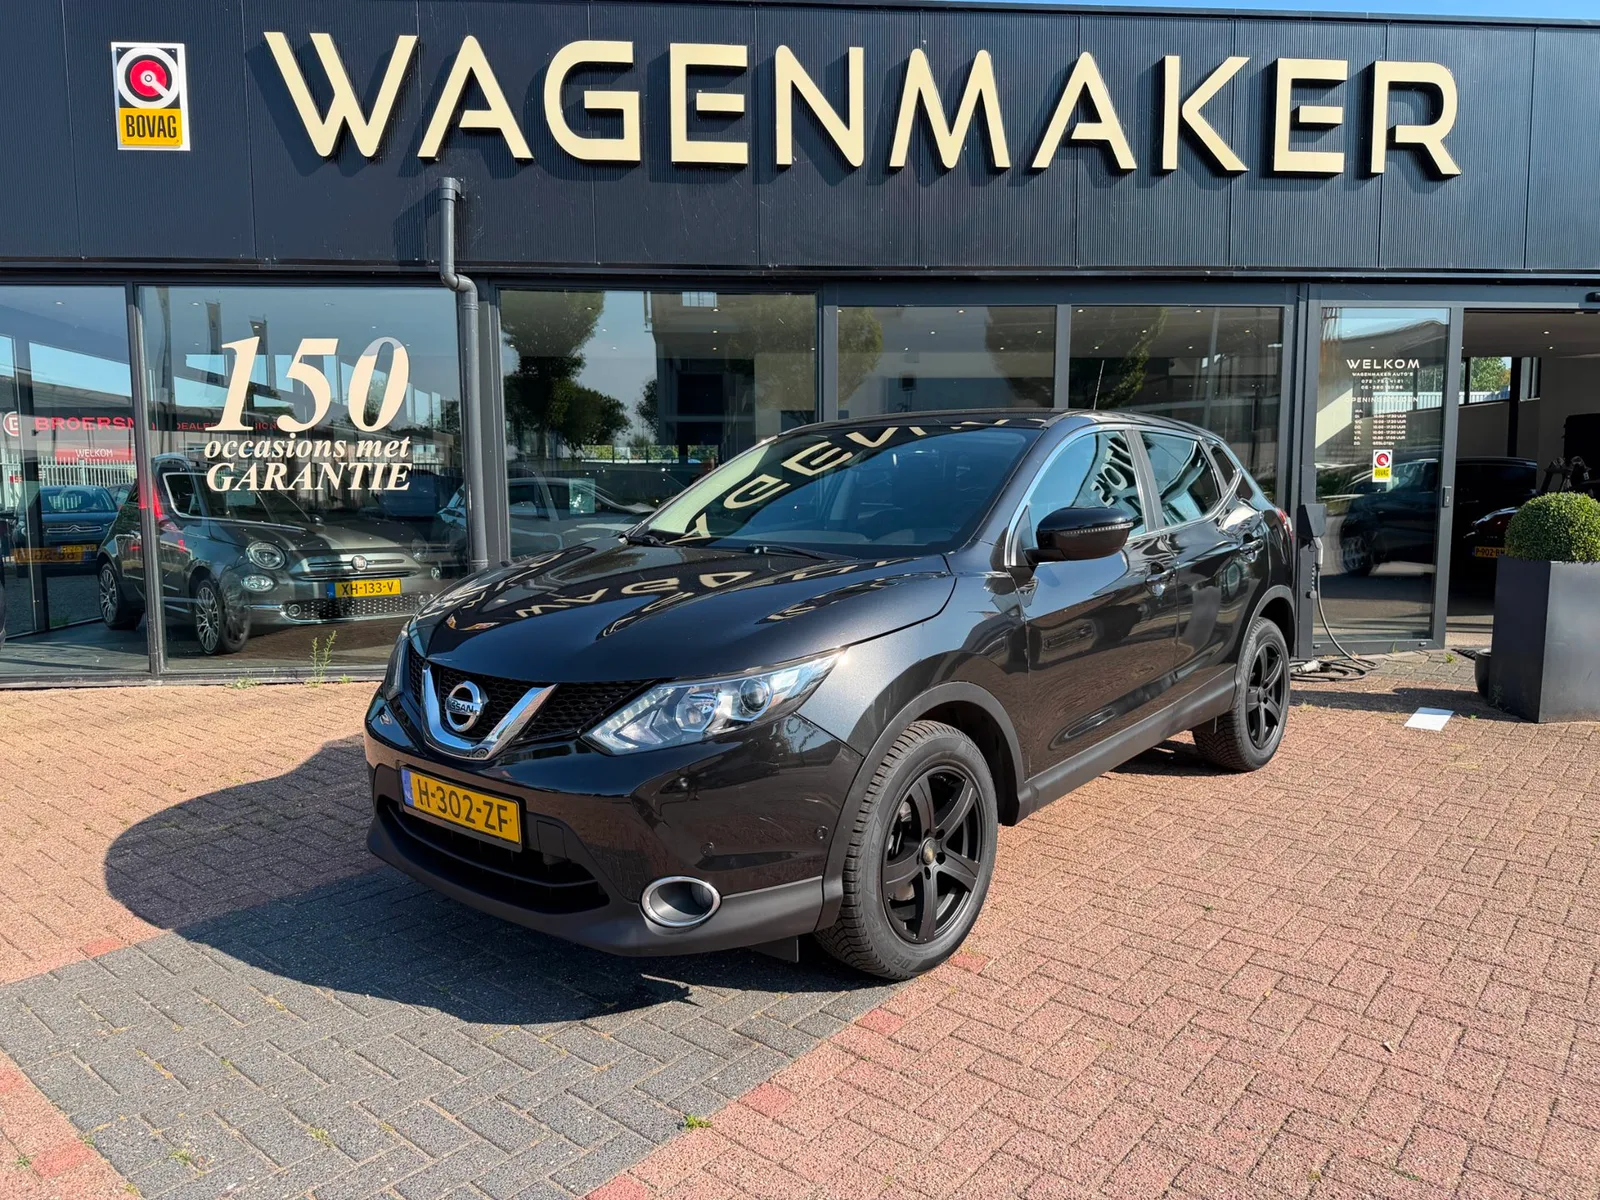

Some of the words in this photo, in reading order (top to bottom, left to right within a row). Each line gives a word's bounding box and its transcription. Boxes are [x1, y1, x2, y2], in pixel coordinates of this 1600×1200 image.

[264, 31, 1462, 177] WAGENMAKER
[125, 114, 177, 139] BOVAG
[1346, 359, 1420, 369] WELKOM
[205, 336, 410, 433] 150
[35, 416, 156, 431] BROERS
[75, 448, 113, 458] WELKOM
[204, 432, 347, 459] occasions
[356, 436, 411, 459] met
[206, 462, 413, 492] GARANTIE
[341, 581, 394, 596] XH-133-V
[448, 699, 475, 713] SSAN
[417, 778, 508, 833] H-302-ZF
